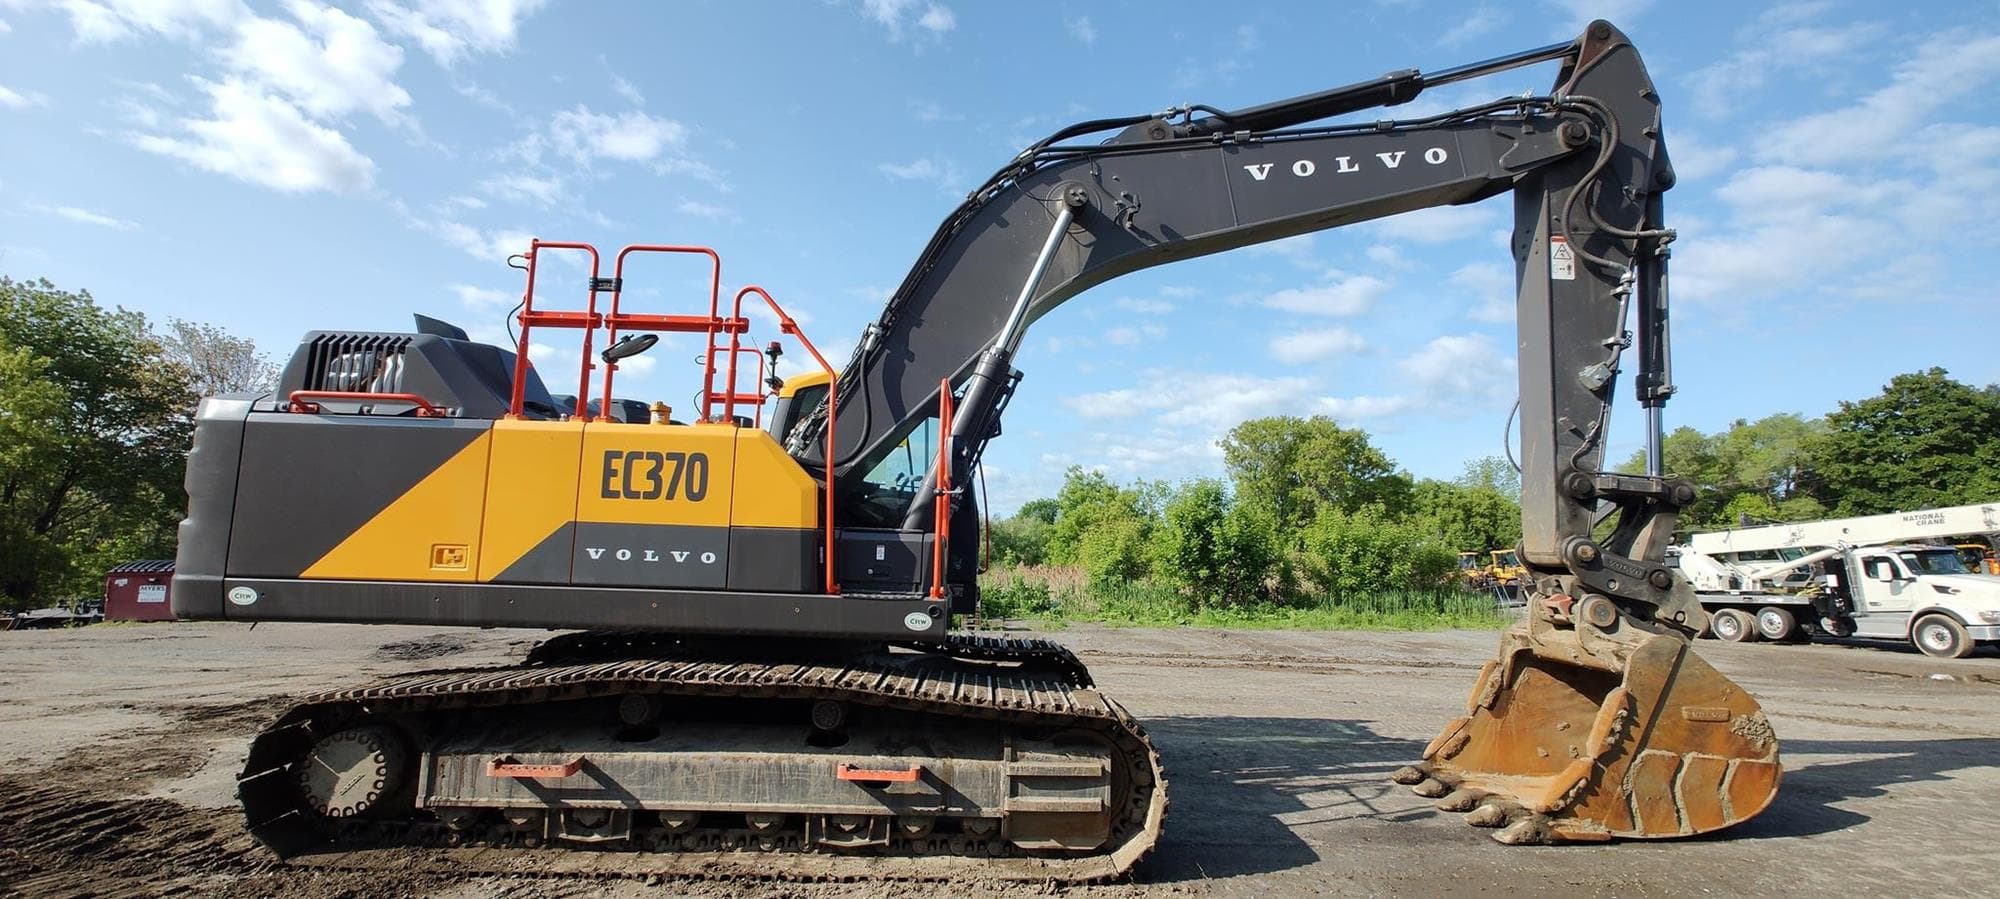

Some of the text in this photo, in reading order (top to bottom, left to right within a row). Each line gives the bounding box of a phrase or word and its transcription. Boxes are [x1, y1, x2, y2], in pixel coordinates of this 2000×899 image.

[1244, 147, 1448, 181] VOLVO
[601, 450, 709, 502] EC370
[1902, 512, 1945, 522] NATIONAL
[586, 548, 716, 564] VOLVO
